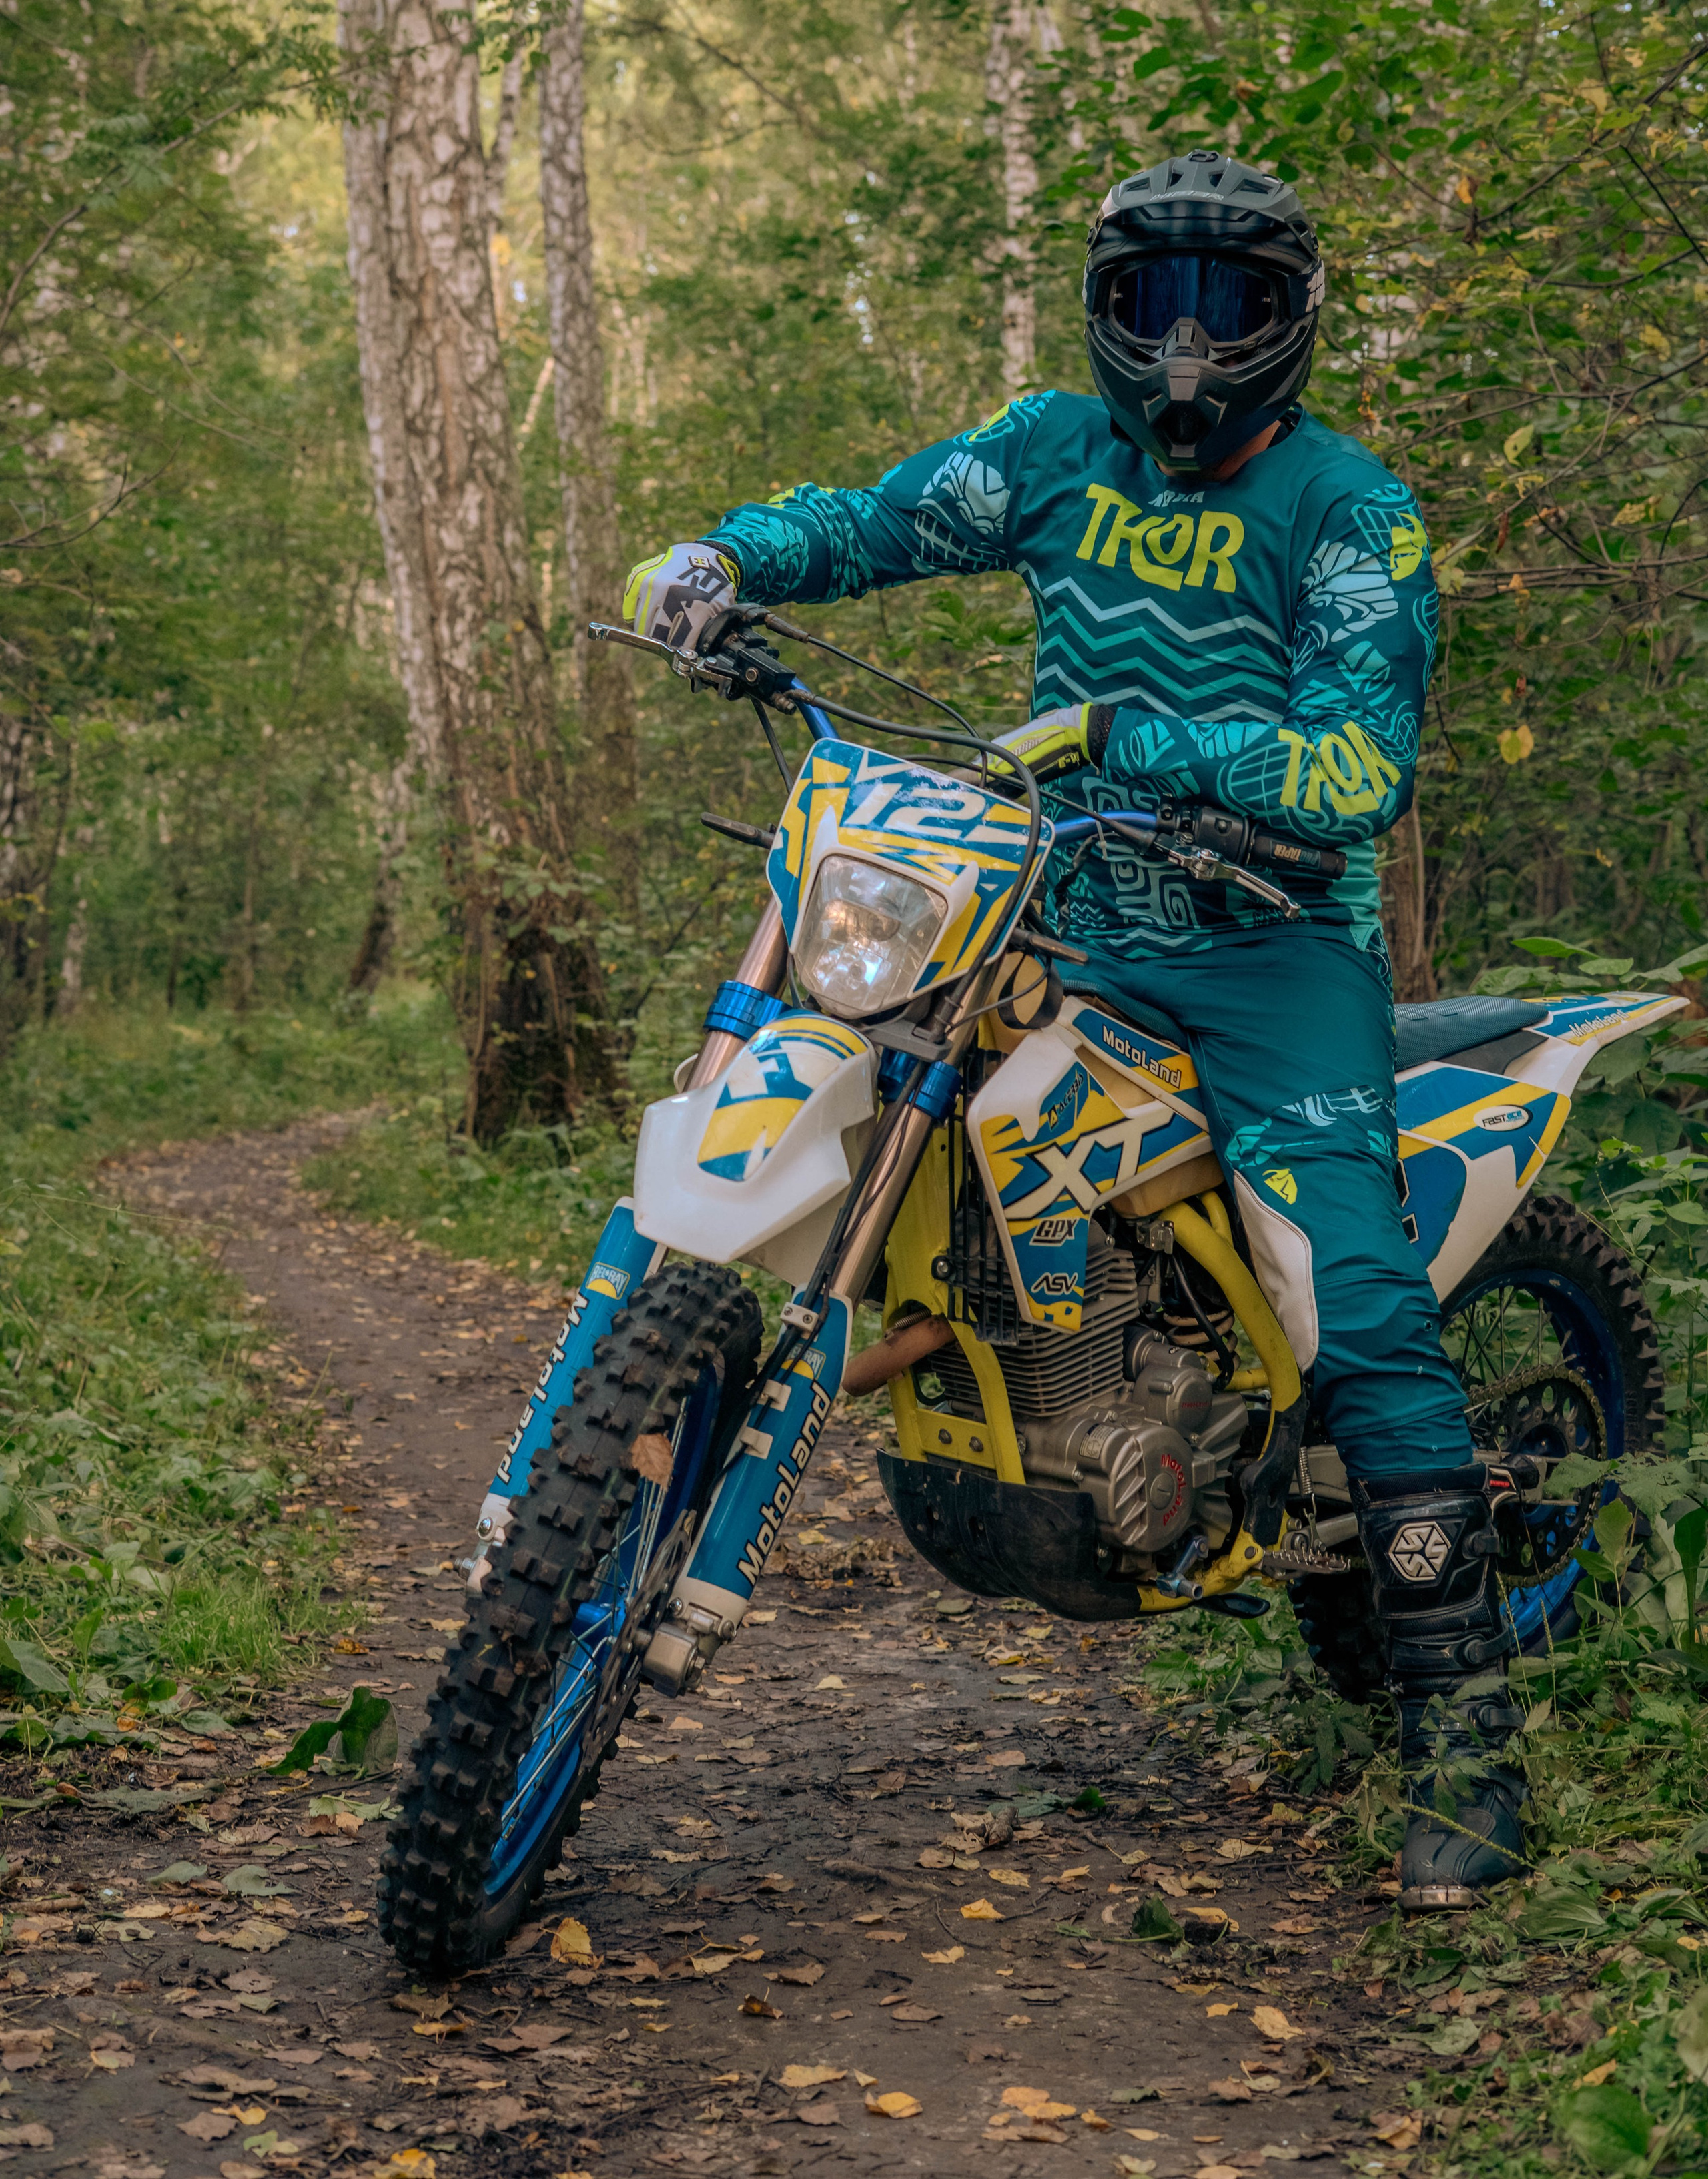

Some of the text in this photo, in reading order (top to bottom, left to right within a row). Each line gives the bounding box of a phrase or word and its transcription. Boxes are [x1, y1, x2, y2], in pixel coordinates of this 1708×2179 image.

[1076, 483, 1244, 593] THOR
[843, 783, 986, 839] 12
[1569, 1009, 1630, 1038] MotoLand
[1102, 1025, 1182, 1089] MotoLand
[1003, 1109, 1174, 1220] XT
[1033, 1218, 1078, 1244] GPX
[1032, 1272, 1078, 1294] ASV
[737, 1379, 831, 1587] MotoLand
[1160, 1453, 1186, 1527] MotoLand
